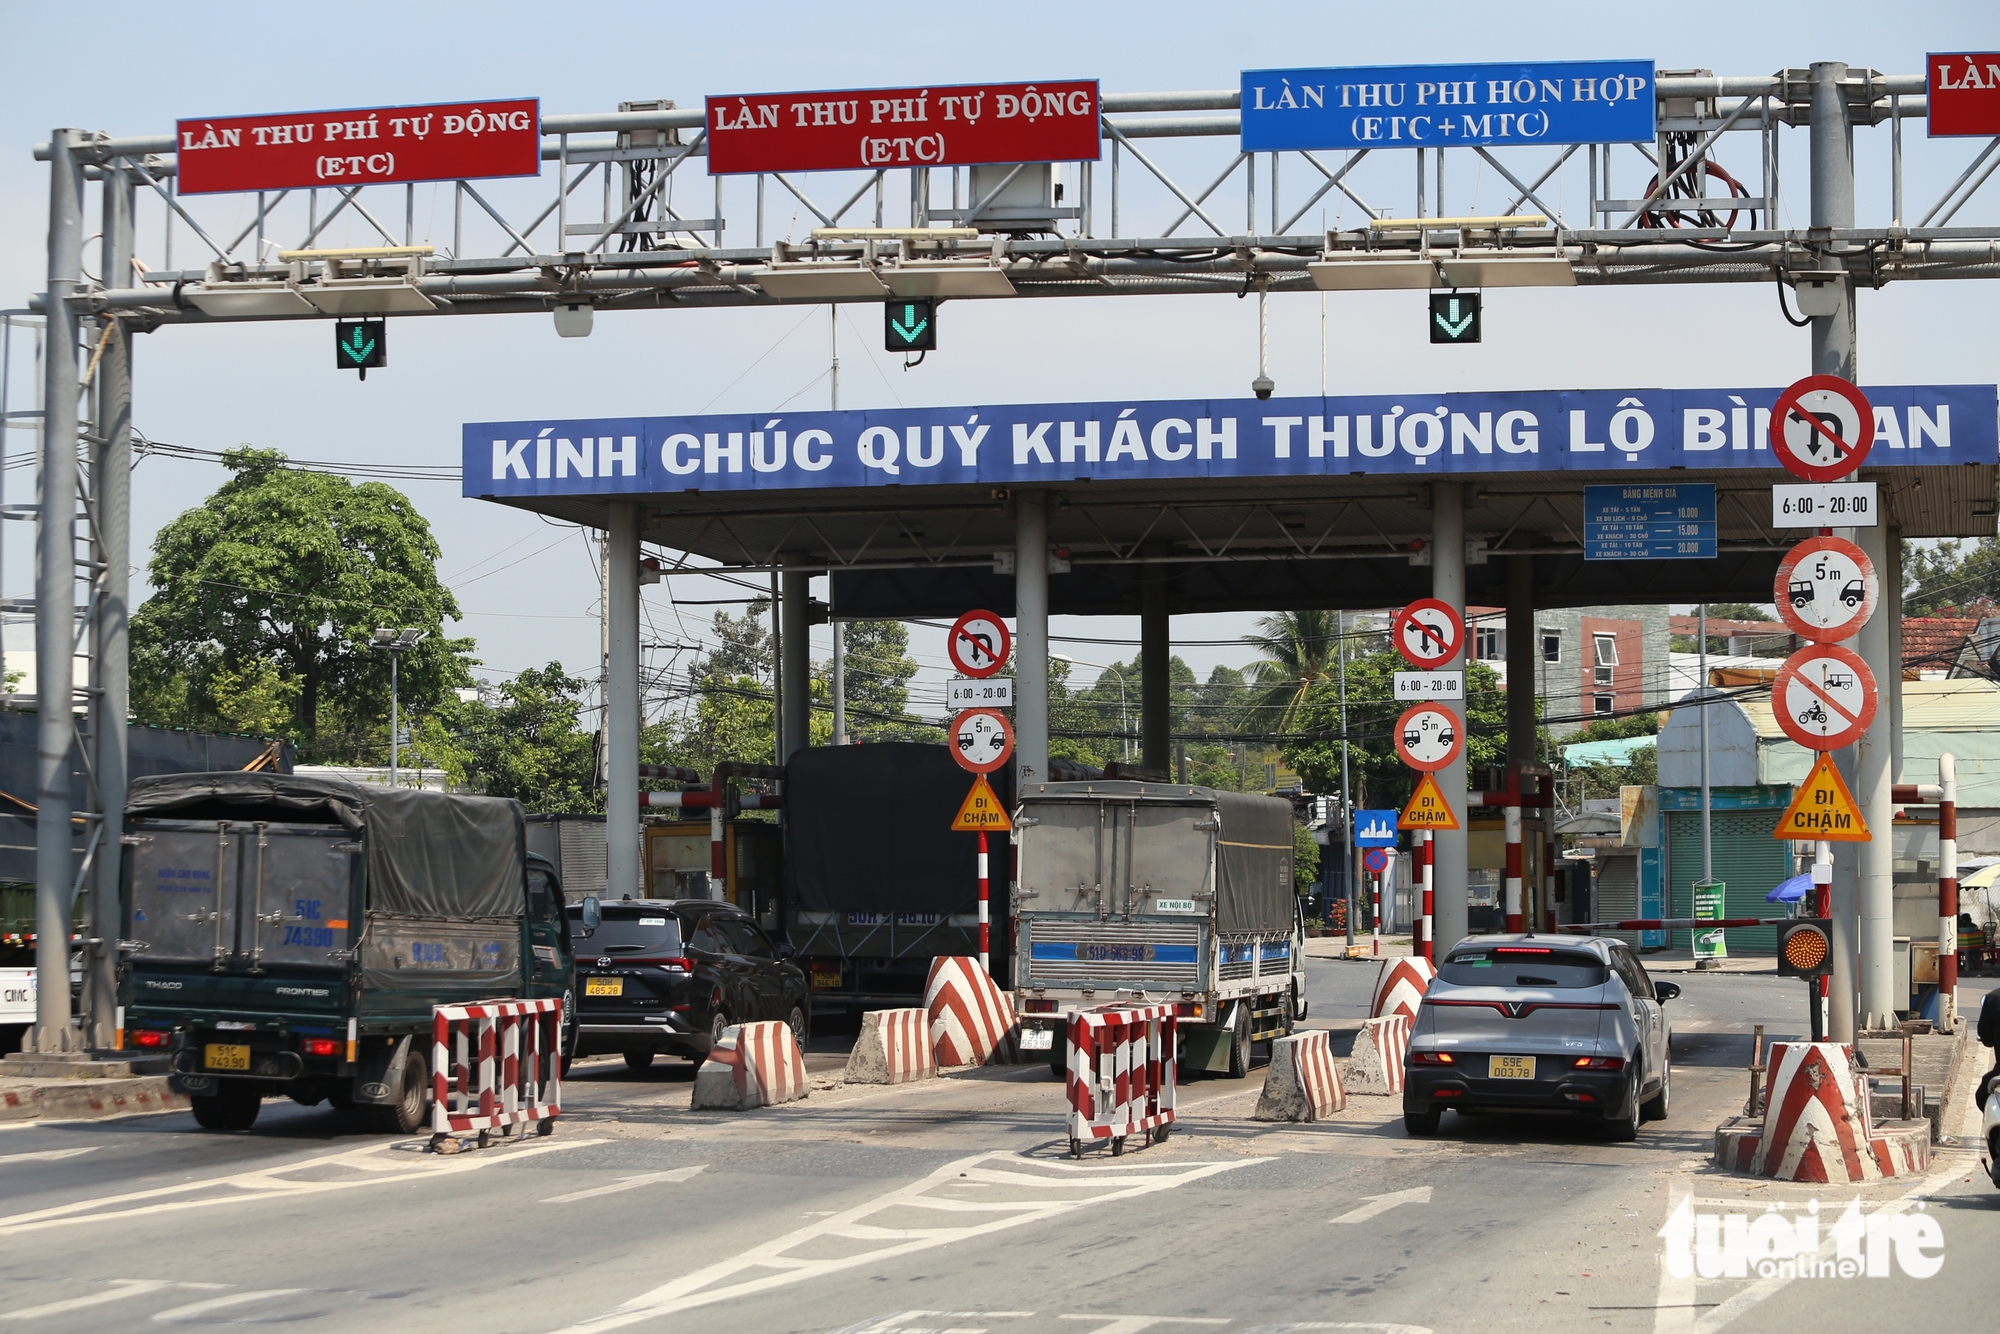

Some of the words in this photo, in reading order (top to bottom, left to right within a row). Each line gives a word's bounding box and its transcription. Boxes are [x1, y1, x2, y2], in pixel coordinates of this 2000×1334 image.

[1253, 78, 1325, 110] LÀN
[1335, 82, 1406, 108] THU
[1572, 73, 1646, 107] HỢP
[715, 97, 779, 131] LÀN
[790, 100, 858, 127] THU
[870, 90, 928, 124] PHÍ
[939, 89, 985, 122] TỰ
[996, 85, 1092, 123] ĐỘNG
[181, 124, 241, 151] LÀN
[251, 122, 314, 145] THU
[324, 113, 379, 141] PHÍ
[388, 113, 433, 140] TỰ
[443, 107, 531, 135] ĐỘNG
[860, 132, 946, 167] (ETC)
[316, 151, 395, 180] (ETC)
[492, 427, 637, 480] KÍNH
[661, 418, 833, 474] CHÚC
[857, 413, 991, 476] QUÝ
[1012, 407, 1238, 466] KHÁCH
[1262, 407, 1540, 466] THƯỢNG
[1569, 396, 1655, 462] LỘ
[1643, 486, 1663, 500] MỆNH
[1665, 486, 1677, 498] GIÁ
[1782, 497, 1813, 514] 6:00
[1830, 496, 1868, 513] 20:00
[1678, 507, 1699, 518] 10.000
[1678, 525, 1699, 536] 15.000
[1678, 542, 1699, 553] 20.000
[1815, 563, 1825, 580] 5
[1829, 569, 1841, 580] m
[1400, 680, 1421, 691] 6:00
[1431, 680, 1457, 691] 20:00
[953, 688, 973, 699] 6:00
[983, 687, 1007, 699] 20:00
[975, 722, 982, 733] 5
[983, 725, 992, 733] m
[1422, 719, 1429, 731] 5
[1430, 723, 1439, 731] m
[975, 798, 988, 808] ĐI
[1421, 797, 1434, 807] ĐI
[1815, 789, 1834, 805] ĐI
[963, 811, 999, 825] CHẬM
[1409, 809, 1446, 825] CHẬM
[295, 900, 321, 920] 51C
[1169, 900, 1181, 910] NỘI
[1183, 900, 1192, 910] BỘ
[283, 926, 334, 948] 74390
[145, 980, 183, 989] THACO
[597, 978, 613, 986] 50H
[276, 987, 330, 997] FRONTIER
[590, 987, 618, 995] 485.28
[218, 1046, 237, 1056] 51C
[210, 1057, 245, 1068] 743.90
[1502, 1057, 1522, 1067] 69E
[1494, 1067, 1530, 1078] 003.78
[366, 1084, 386, 1096] KIA
